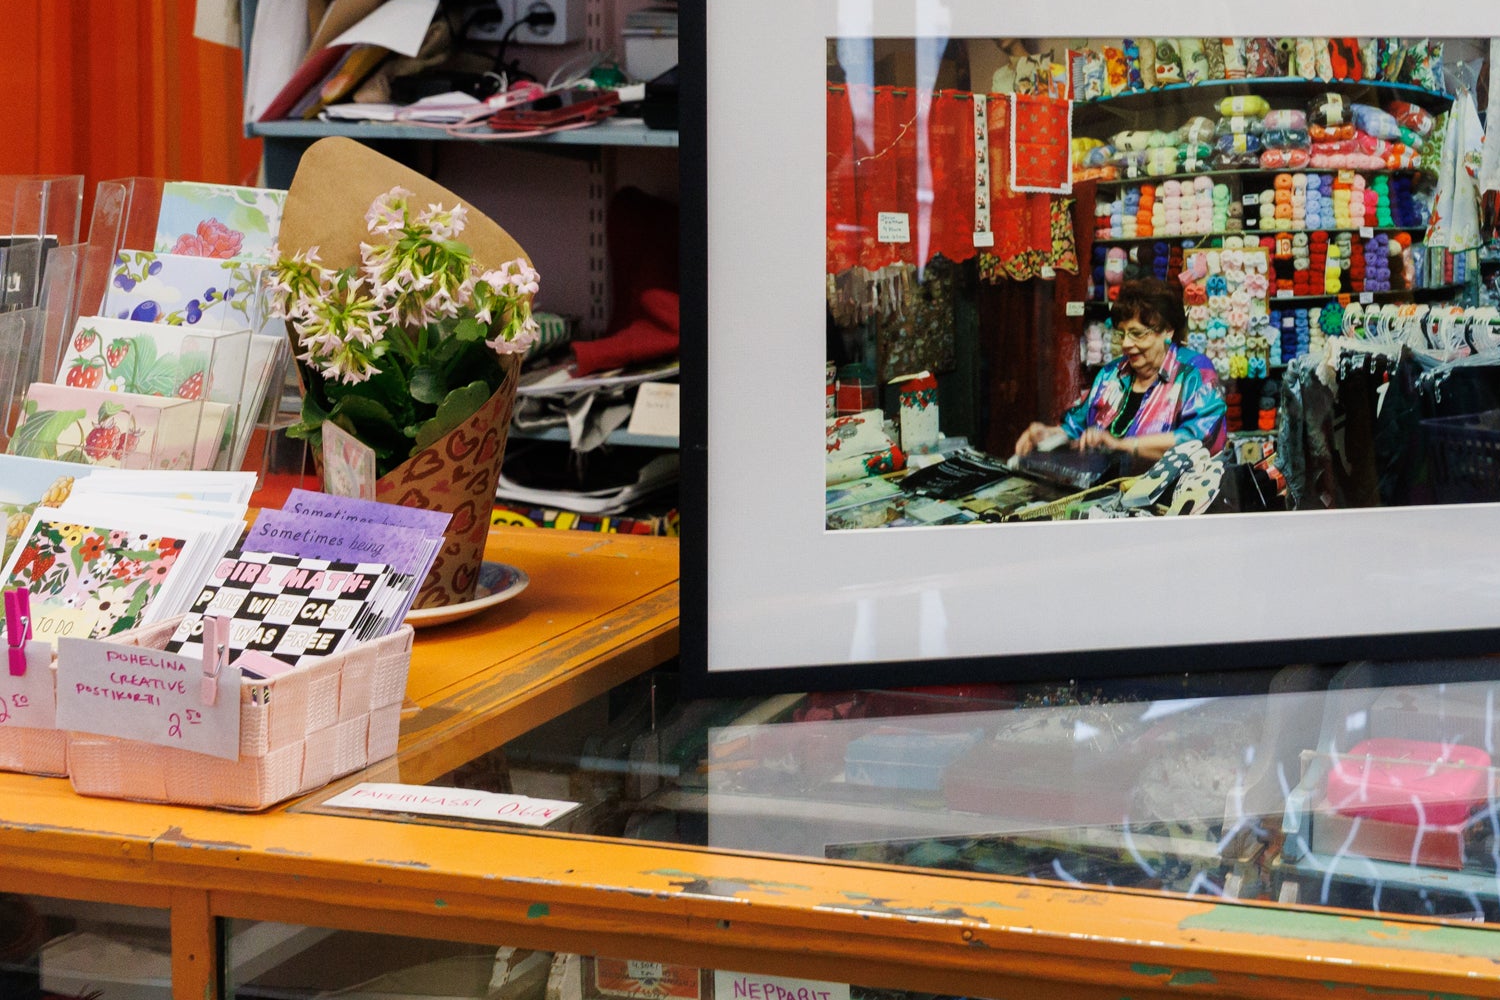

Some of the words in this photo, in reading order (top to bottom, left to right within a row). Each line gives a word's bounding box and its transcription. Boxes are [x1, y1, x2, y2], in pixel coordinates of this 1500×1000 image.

[259, 522, 344, 546] Sometimes
[349, 537, 386, 558] being
[214, 563, 271, 585] GIRL
[196, 590, 247, 612] PAID
[246, 596, 297, 617] WITH
[300, 602, 353, 623] CASH
[35, 616, 51, 633] TO
[58, 620, 75, 636] DO
[234, 624, 278, 645] WAS
[279, 629, 335, 650] FREE
[110, 671, 187, 695] CREATIVE
